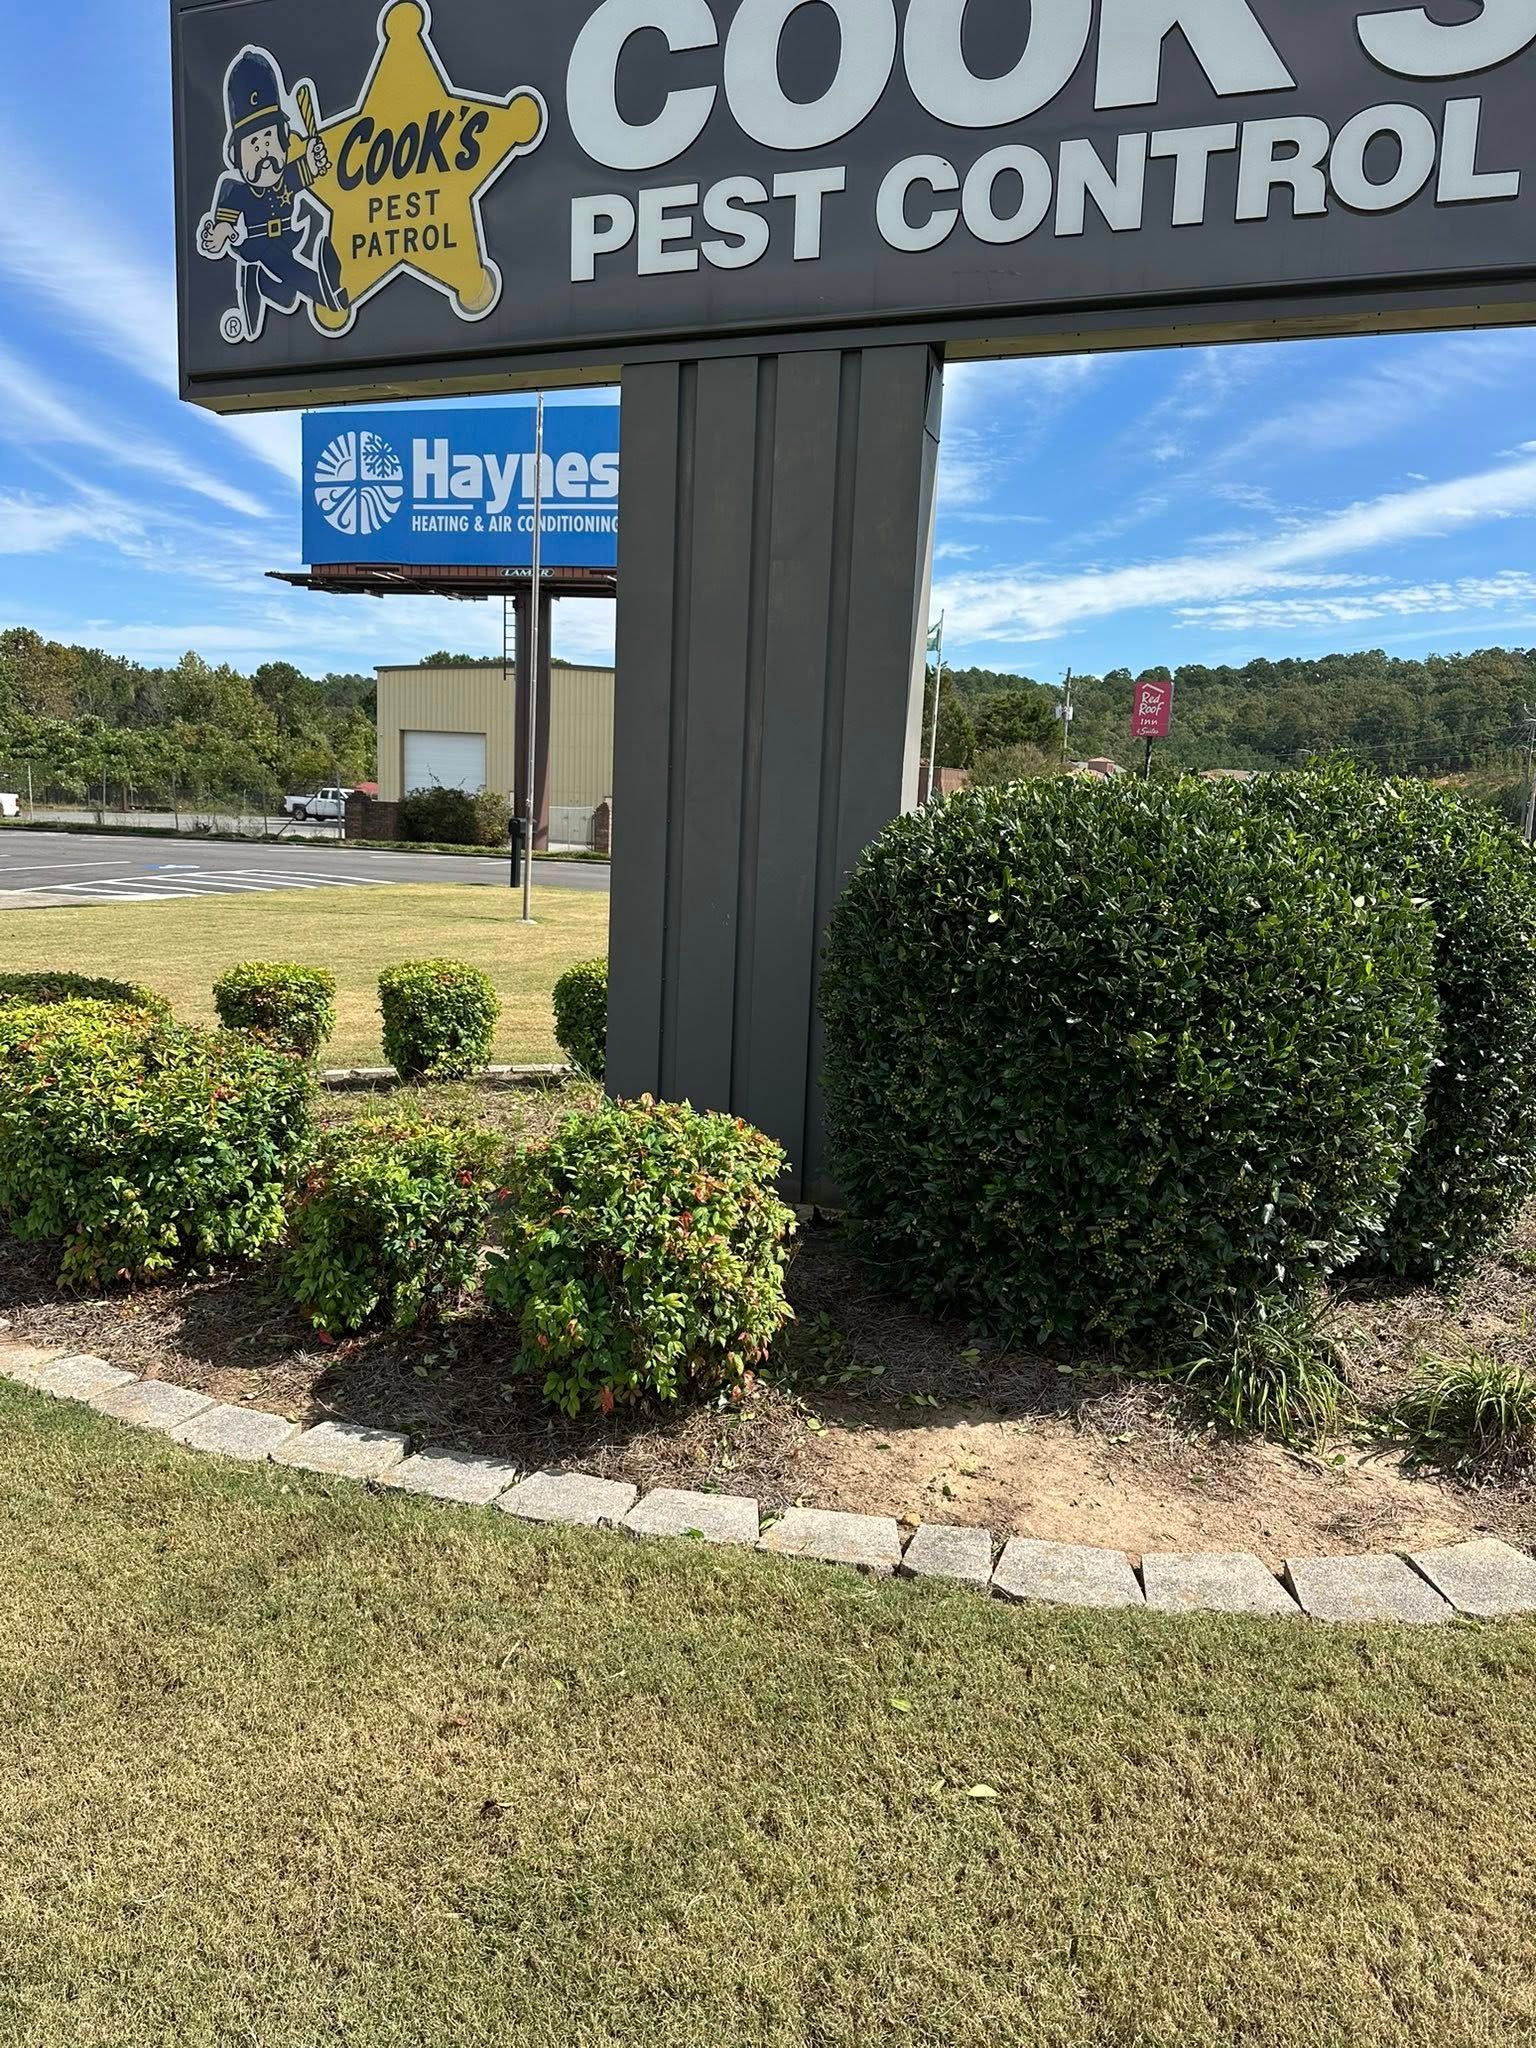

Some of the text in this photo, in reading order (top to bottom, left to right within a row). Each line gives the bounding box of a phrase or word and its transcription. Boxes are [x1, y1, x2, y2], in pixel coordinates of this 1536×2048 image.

[337, 105, 490, 191] COOK'S
[368, 189, 441, 224] PEST
[570, 97, 1521, 282] PEST CONTROL
[352, 223, 457, 260] PATROL
[412, 438, 620, 514] Haynes
[412, 515, 469, 533] HEATING
[474, 515, 485, 533] &
[488, 515, 512, 532] AIR
[504, 569, 549, 578] LAMR
[1139, 702, 1165, 716] Roof
[1142, 691, 1162, 704] Red
